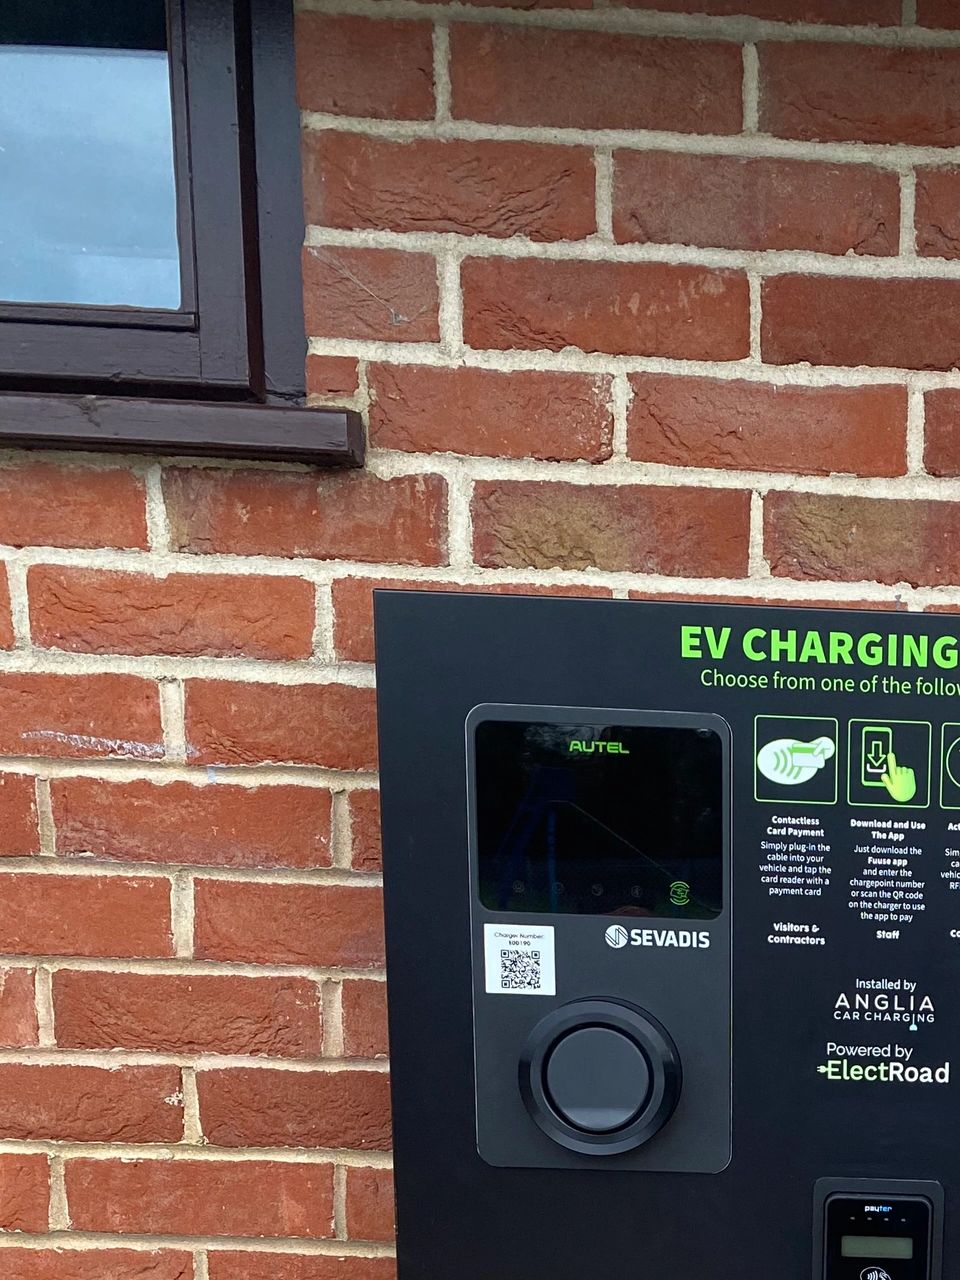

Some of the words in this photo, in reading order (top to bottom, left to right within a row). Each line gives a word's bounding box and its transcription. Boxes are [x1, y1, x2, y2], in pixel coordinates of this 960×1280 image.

[681, 625, 731, 659] EV
[742, 627, 958, 669] CHARGING
[701, 669, 768, 688] Choose
[773, 671, 815, 690] from
[821, 678, 855, 692] one
[859, 675, 878, 693] of
[882, 676, 911, 694] the
[569, 740, 630, 754] AUTEL
[772, 816, 819, 825] Contactless
[850, 819, 892, 828] Download
[893, 821, 909, 829] and
[911, 821, 926, 829] Use
[767, 827, 786, 835] Card
[788, 828, 824, 837] Payment
[871, 831, 887, 839] The
[888, 832, 904, 841] App
[760, 841, 787, 851] Simply
[789, 842, 816, 852] plug-in
[817, 843, 830, 851] the
[854, 845, 870, 853] Just
[871, 845, 908, 854] download
[910, 847, 922, 855] the
[767, 853, 788, 861] cable
[789, 853, 805, 861] into
[868, 857, 891, 865] Fuuse
[892, 859, 908, 867] app
[759, 864, 787, 872] vehicle
[788, 865, 802, 873] and
[804, 866, 817, 874] tap
[819, 866, 832, 874] the
[863, 868, 877, 876] and
[900, 869, 912, 877] the
[761, 875, 778, 883] card
[780, 876, 805, 884] reader
[806, 877, 823, 885] with
[850, 878, 894, 888] chargepoint
[895, 880, 925, 888] number
[769, 888, 803, 896] payment
[804, 888, 821, 896] card
[879, 890, 891, 898] the
[893, 891, 904, 900] QR
[905, 891, 923, 899] code
[874, 901, 902, 911] charger
[774, 922, 809, 932] Visitors
[812, 924, 819, 932] &
[630, 929, 710, 949] SEVADIS
[877, 930, 900, 939] Staff
[768, 935, 825, 945] Contractors
[856, 978, 900, 990] Installed
[903, 980, 917, 992] by
[835, 993, 935, 1011] ANGLIA
[834, 1011, 860, 1020] CAR
[865, 1012, 935, 1025] CHARGING
[827, 1042, 891, 1057] Powered
[895, 1044, 913, 1061] by
[827, 1059, 949, 1083] ElectRoad
